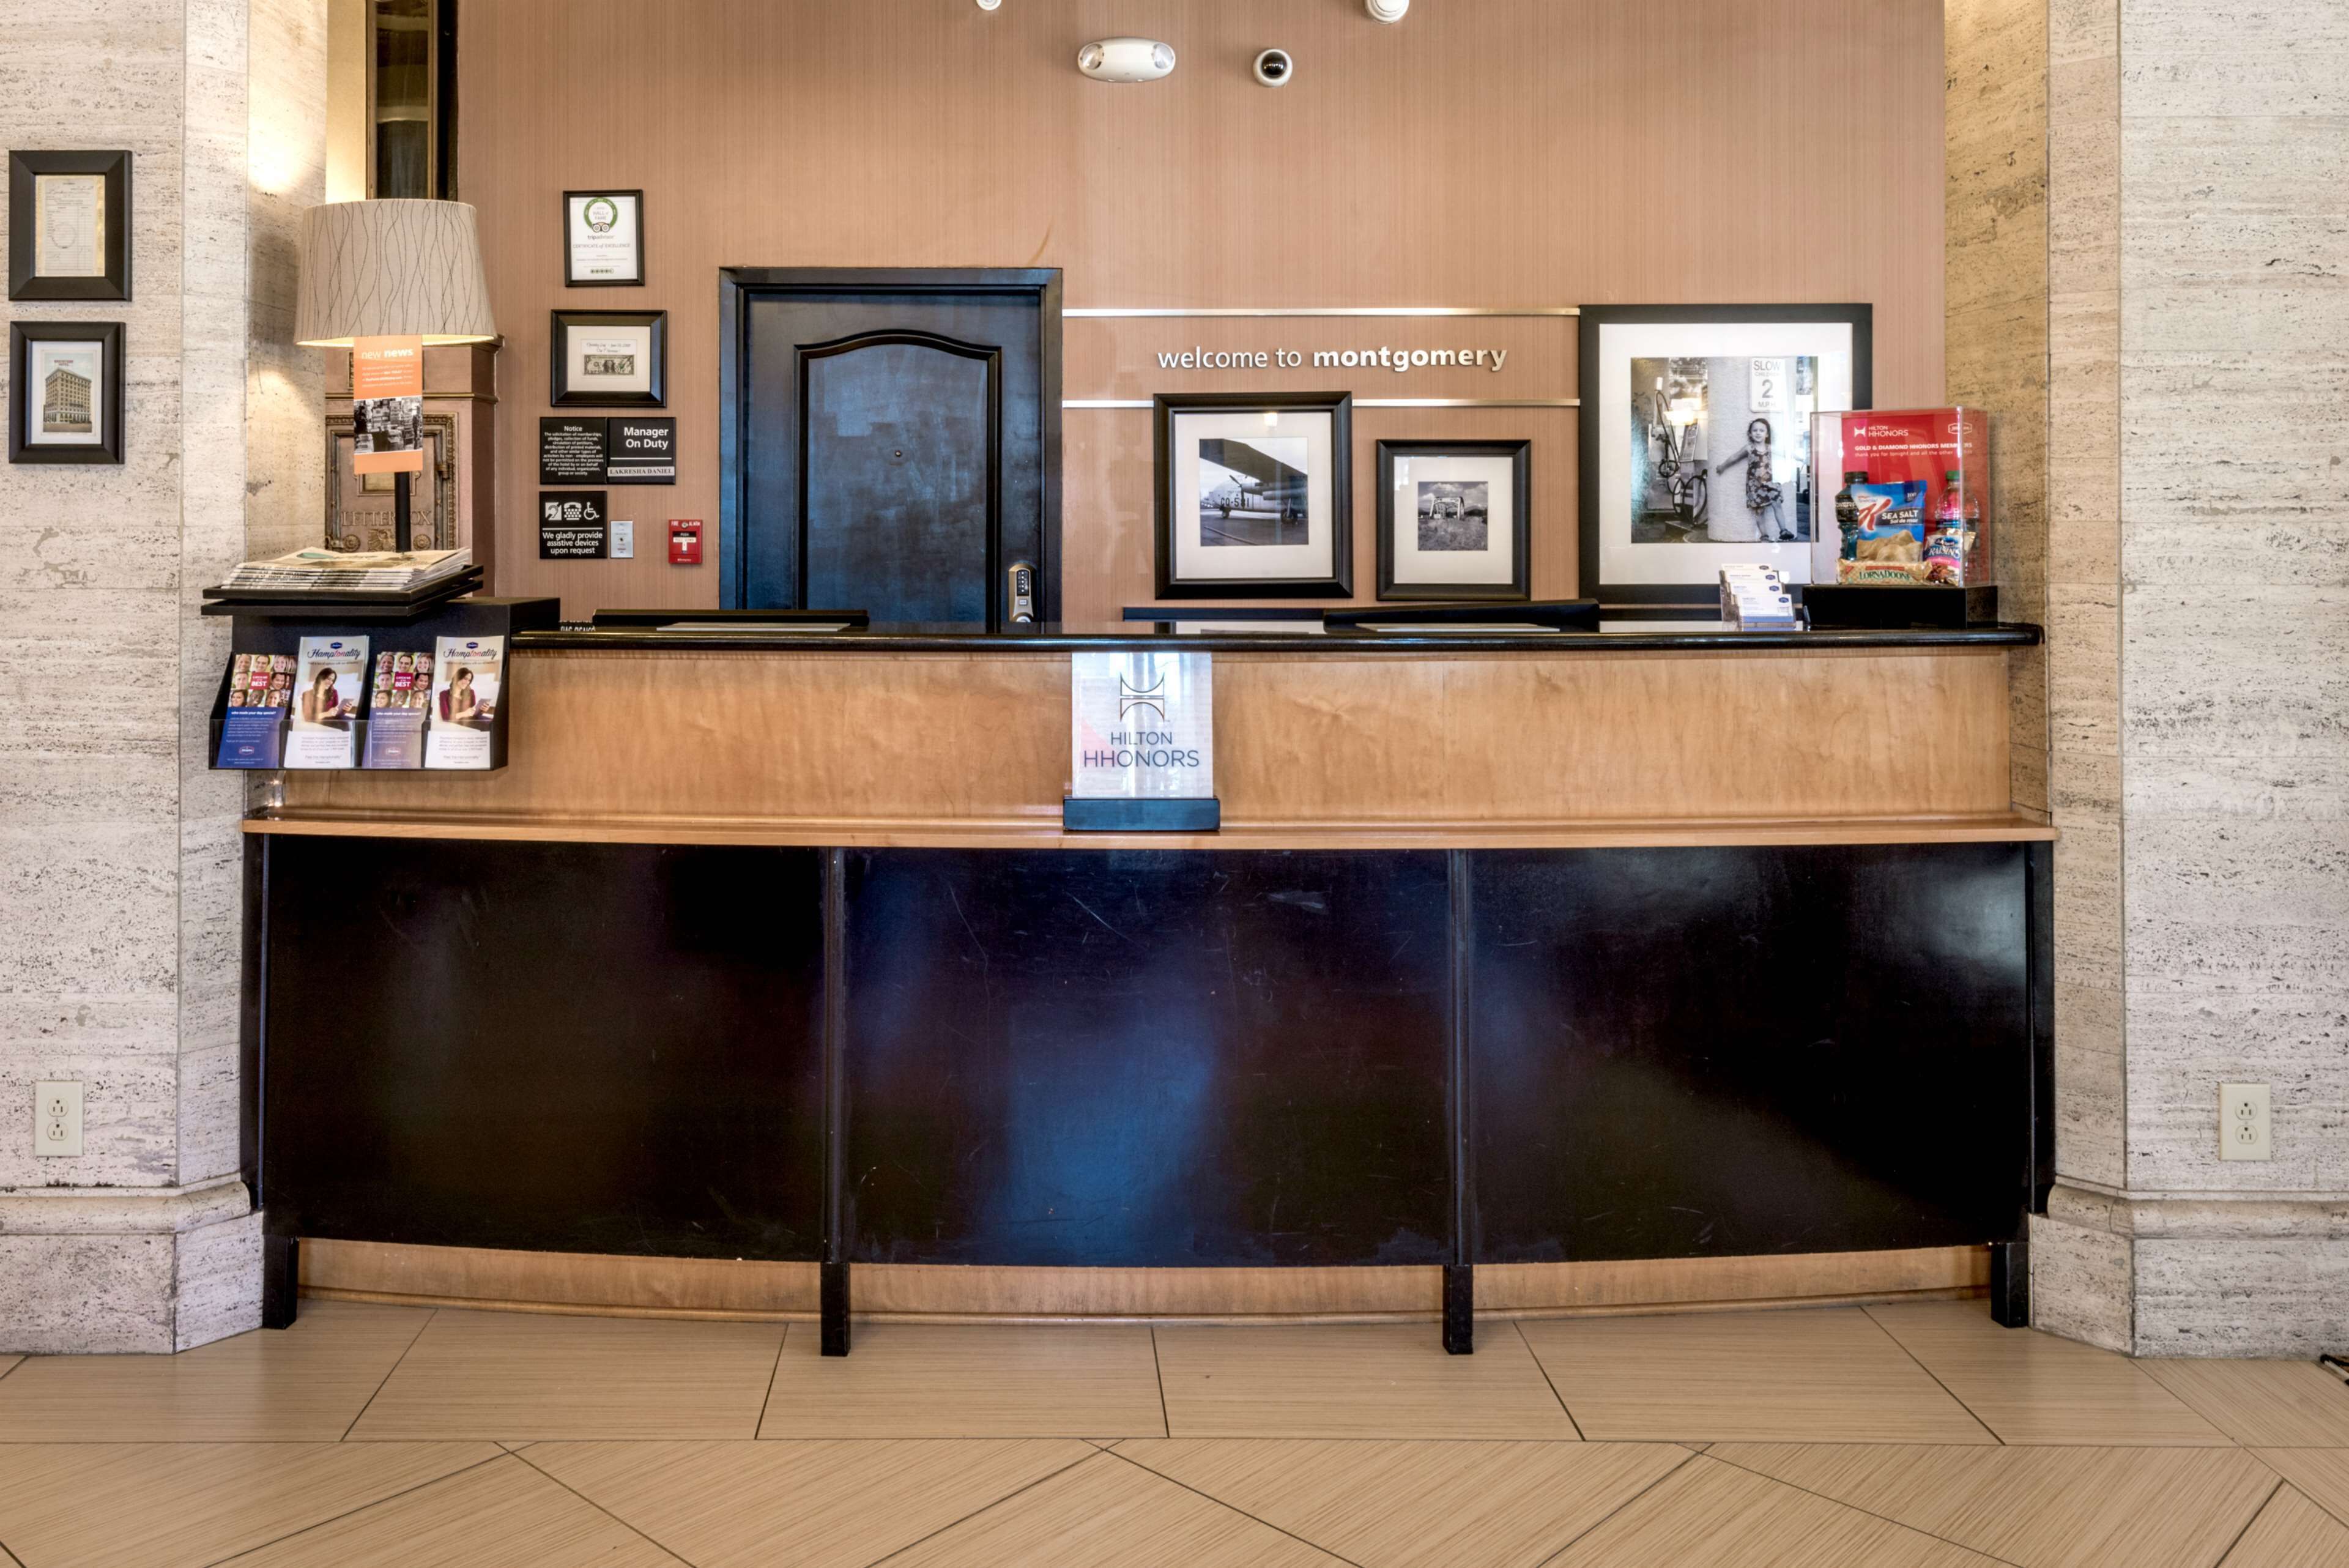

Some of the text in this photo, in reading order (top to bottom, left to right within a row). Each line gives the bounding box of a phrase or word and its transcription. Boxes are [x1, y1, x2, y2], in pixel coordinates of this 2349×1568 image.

[362, 349, 414, 360] new news
[1157, 346, 1508, 371] welcome to montgomery
[1753, 360, 1781, 371] SLOW
[624, 427, 669, 438] Manager
[626, 439, 668, 450] On Duty
[1858, 498, 1892, 530] K
[555, 532, 576, 541] gladly
[577, 532, 603, 541] provide
[1860, 571, 1884, 580] LORNA
[307, 648, 361, 660] Hamptonality
[443, 648, 497, 660] Hamptonality
[1111, 732, 1173, 745] HILTON
[1084, 750, 1199, 767] HHONORS
